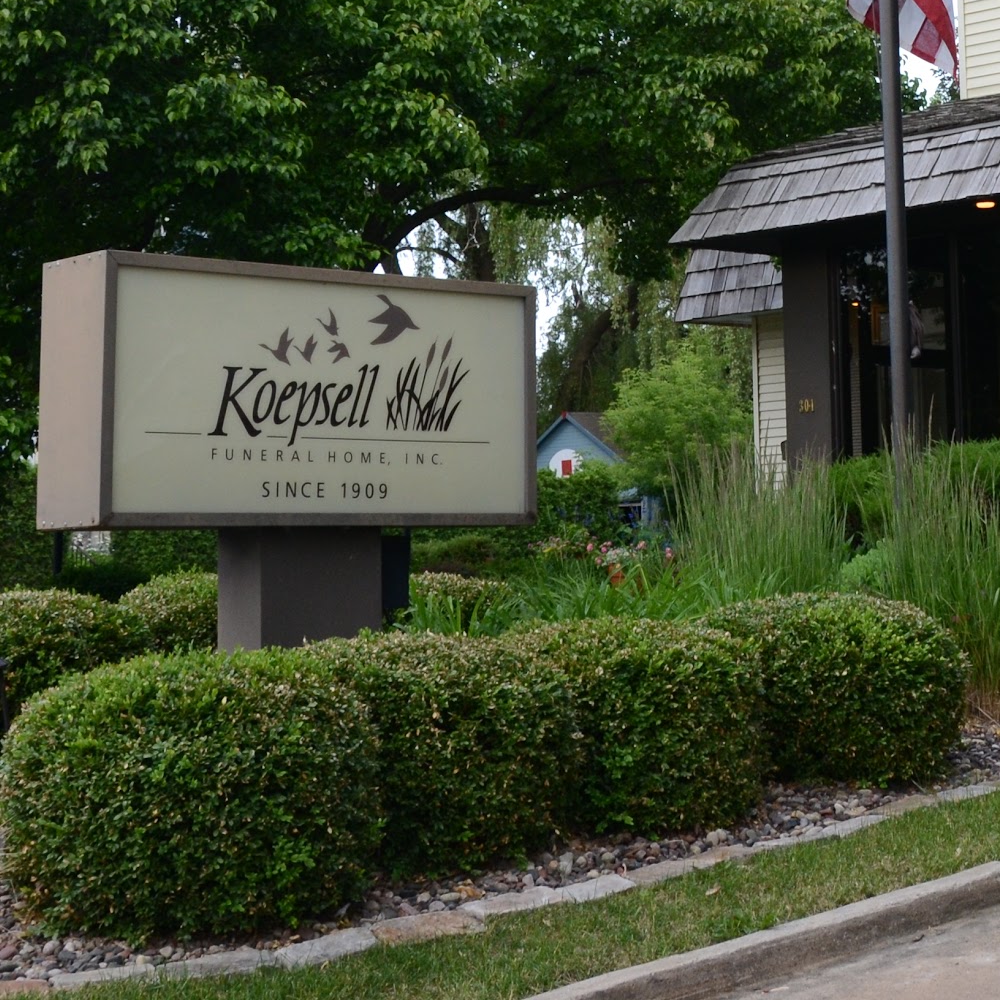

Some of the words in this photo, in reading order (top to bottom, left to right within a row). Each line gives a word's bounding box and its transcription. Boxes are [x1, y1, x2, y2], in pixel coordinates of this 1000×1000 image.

[207, 364, 379, 446] Koepsell
[211, 448, 314, 462] FUNERAL
[328, 451, 391, 465] HOME,
[404, 453, 443, 465] INC.
[261, 481, 325, 498] SINCE
[340, 482, 388, 499] 1909
